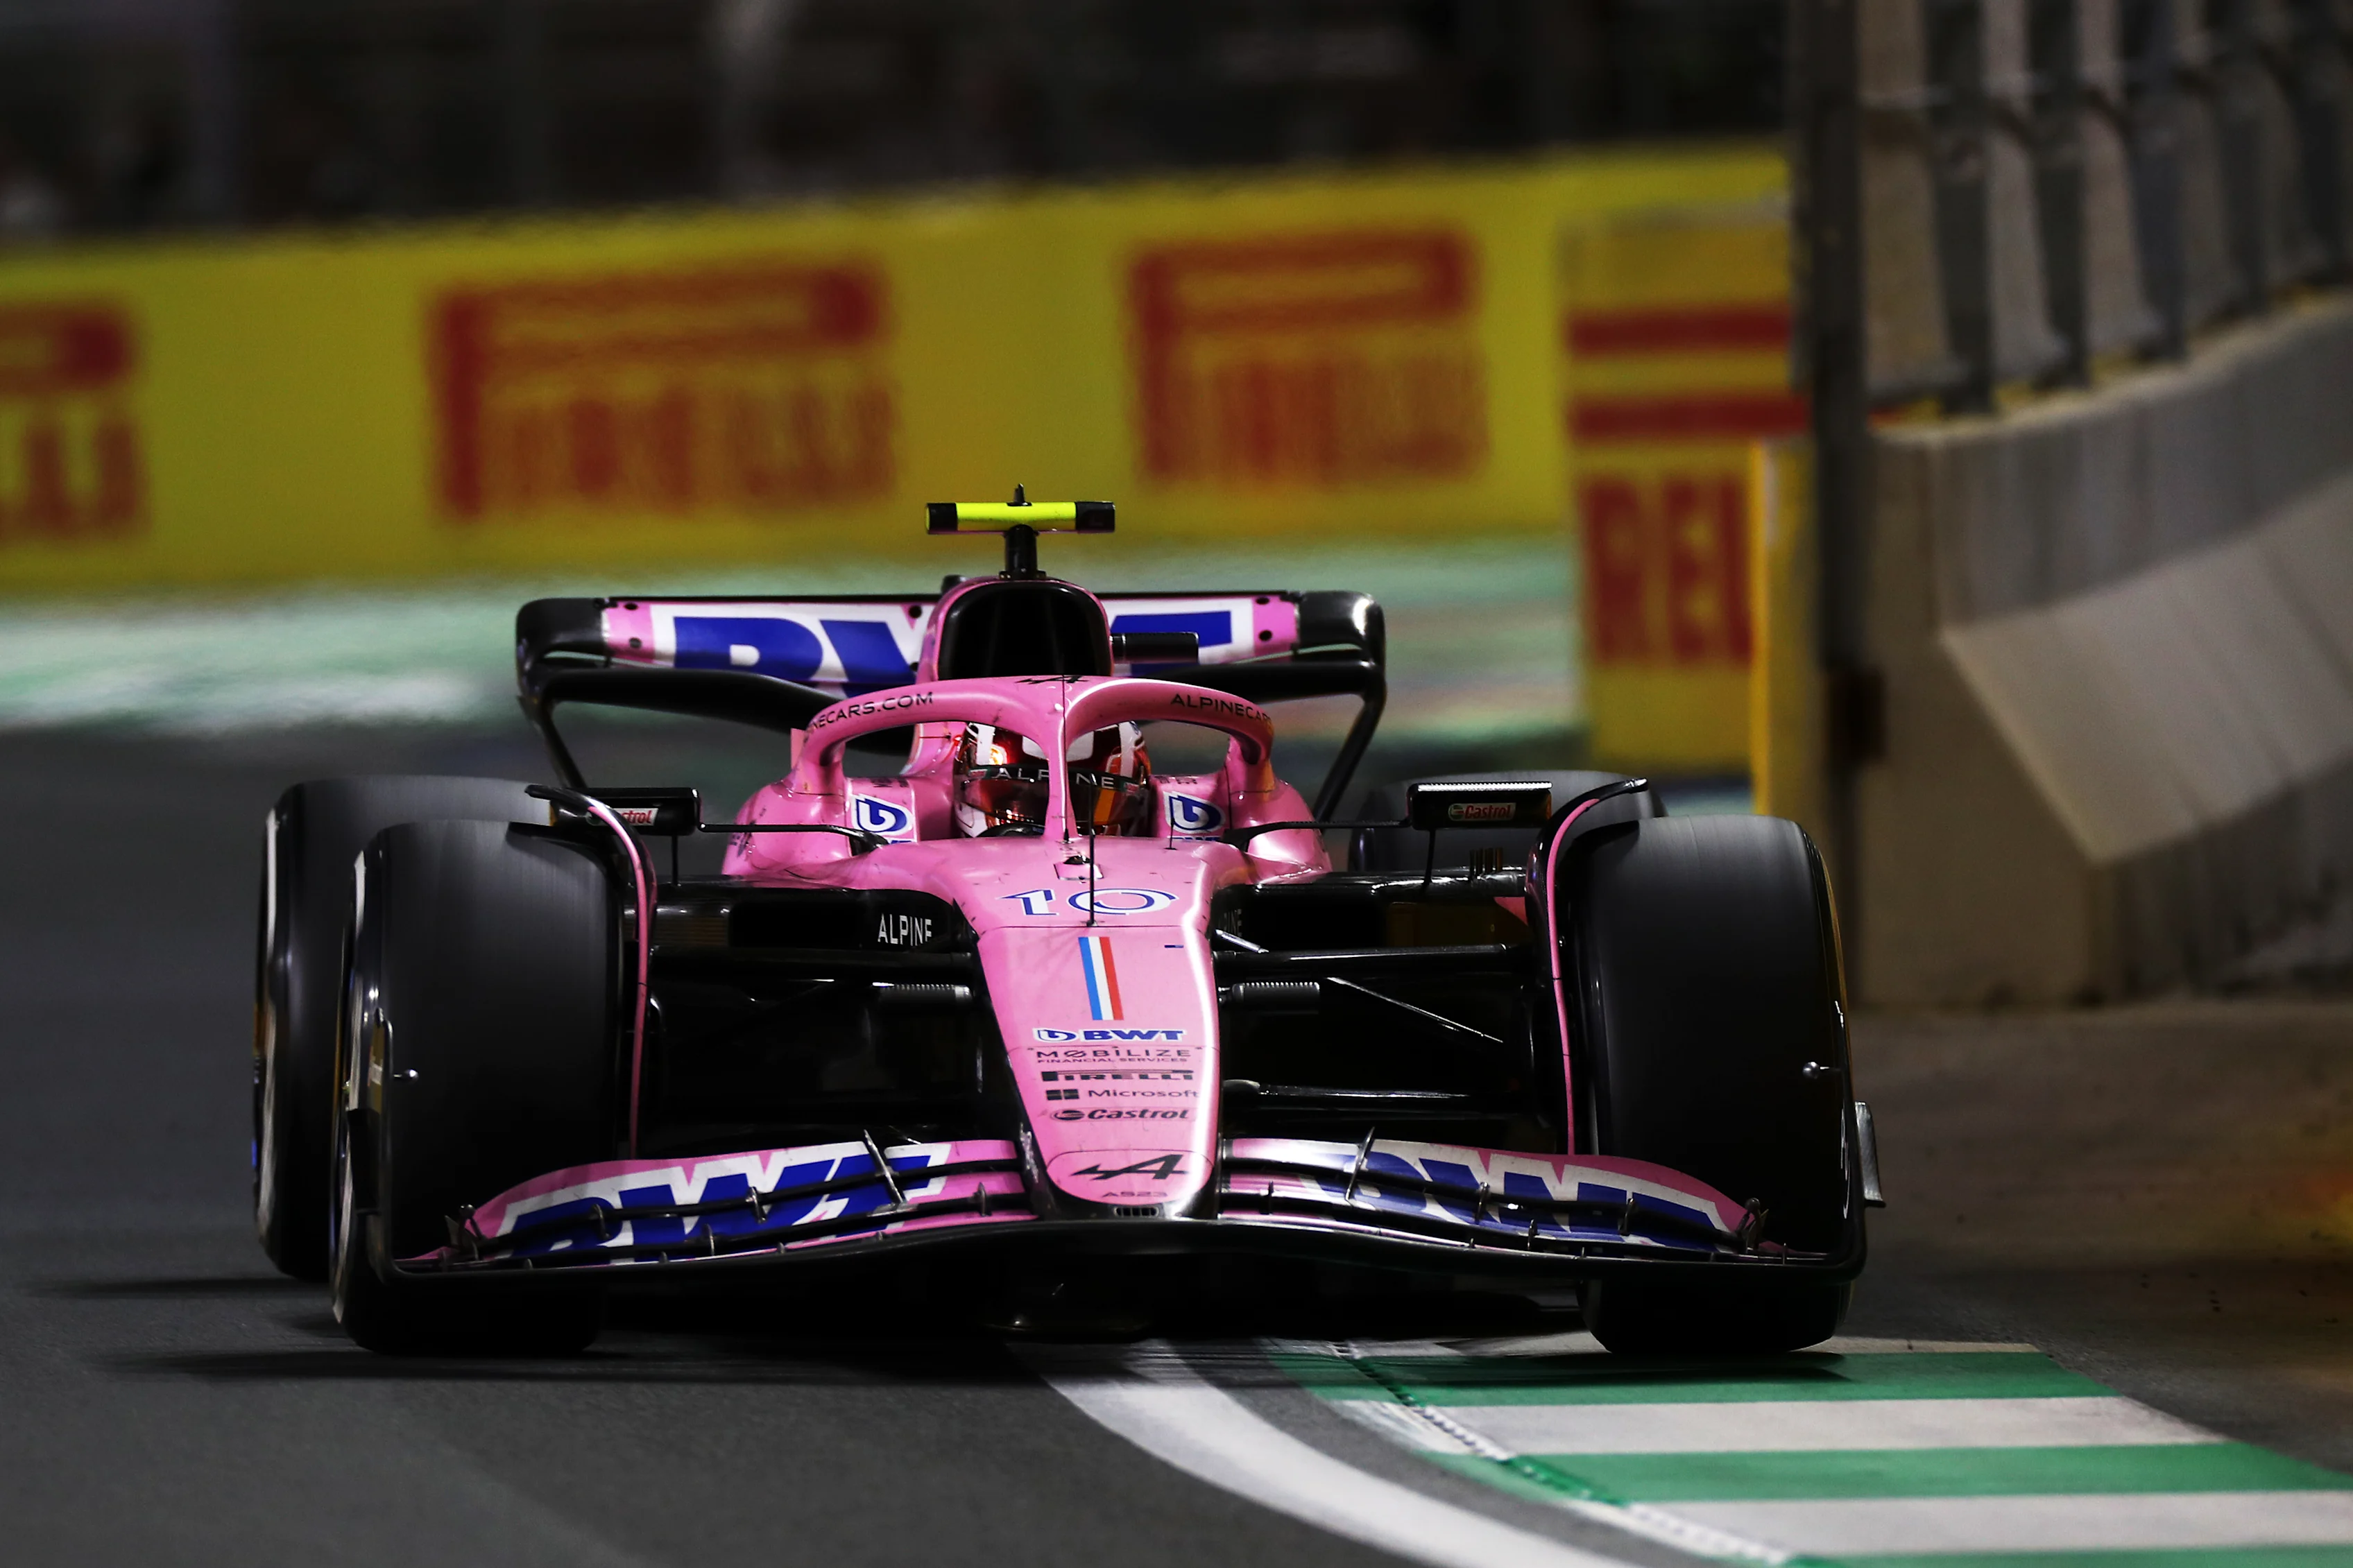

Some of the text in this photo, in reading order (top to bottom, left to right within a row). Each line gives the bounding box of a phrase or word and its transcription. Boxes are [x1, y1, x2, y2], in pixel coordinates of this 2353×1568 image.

[1170, 693, 1272, 724] ALPINECAR
[992, 767, 1115, 789] ALPNE
[1464, 804, 1511, 819] Castrol
[998, 888, 1179, 915] 10
[1082, 1030, 1184, 1040] BWT
[1041, 1069, 1195, 1082] PIRELLI
[1087, 1089, 1199, 1098] Microsoft
[1087, 1108, 1189, 1120] Castrol
